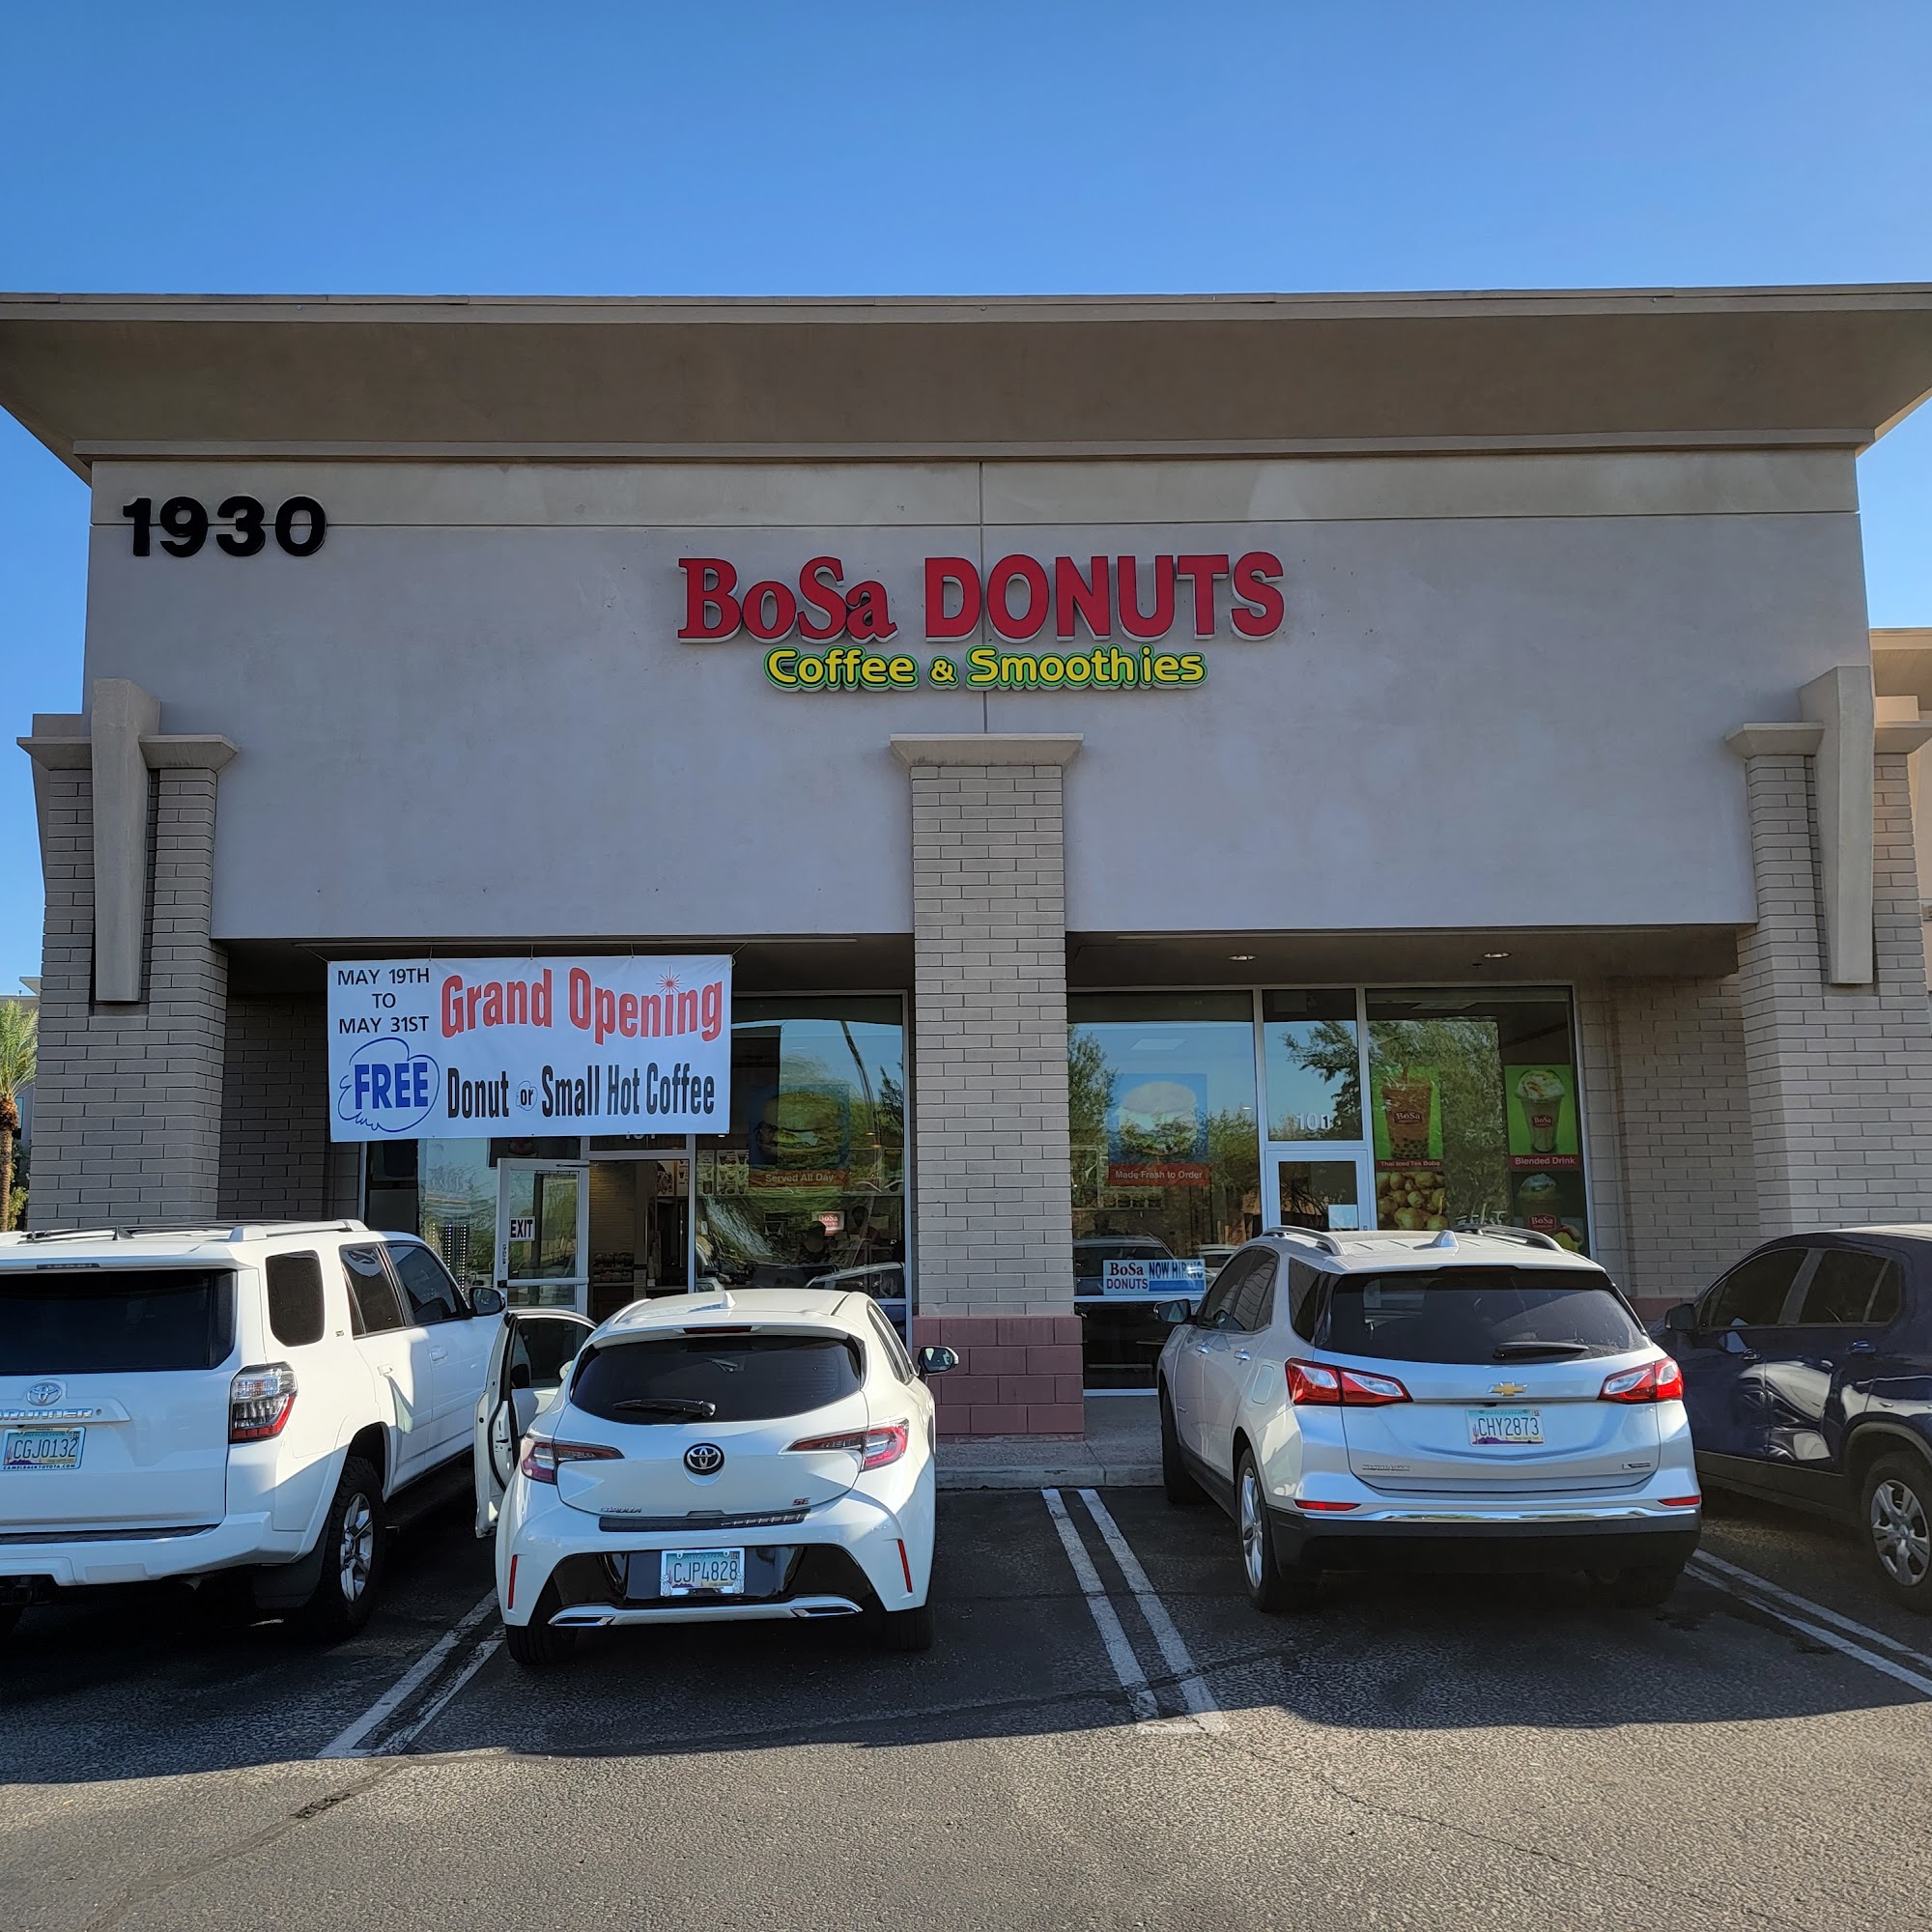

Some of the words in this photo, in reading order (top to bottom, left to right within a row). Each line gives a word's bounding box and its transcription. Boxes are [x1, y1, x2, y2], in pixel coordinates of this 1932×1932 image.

[123, 496, 327, 557] 1930
[677, 556, 896, 644] BoSa
[924, 552, 1284, 643] DONUTS
[765, 646, 919, 690] Coffee
[928, 654, 959, 688] &
[965, 644, 1208, 689] Smoothies
[337, 969, 382, 985] MAY
[388, 967, 430, 984] 19TH
[372, 992, 396, 1009] TO
[440, 967, 553, 1039] Grand
[567, 965, 724, 1046] Opening
[338, 1017, 382, 1034] MAY
[389, 1015, 430, 1032] 31ST
[354, 1062, 429, 1110] FREE
[447, 1067, 509, 1119] Donut
[520, 1089, 534, 1108] or
[541, 1065, 600, 1118] Small
[608, 1064, 639, 1116] Hot
[646, 1062, 715, 1115] Coffee
[1515, 1156, 1550, 1165] Blended
[1552, 1156, 1576, 1165] Drink
[765, 1173, 799, 1183] Served
[801, 1173, 813, 1182] All
[815, 1172, 835, 1184] Day
[1115, 1170, 1139, 1179] Made
[1141, 1170, 1165, 1179] Fresh
[1167, 1170, 1176, 1179] to
[1178, 1170, 1203, 1179] Order
[510, 1219, 533, 1238] EXIT
[1531, 1215, 1553, 1225] BoSa
[1109, 1262, 1144, 1276] BoSa
[1149, 1262, 1170, 1280] NOW
[1106, 1278, 1148, 1290] DONUTS
[0, 1408, 93, 1420] RUNNER
[1478, 1417, 1539, 1436] CHY2873
[14, 1438, 78, 1459] CGJ0132
[673, 1560, 738, 1583] CJP4828
